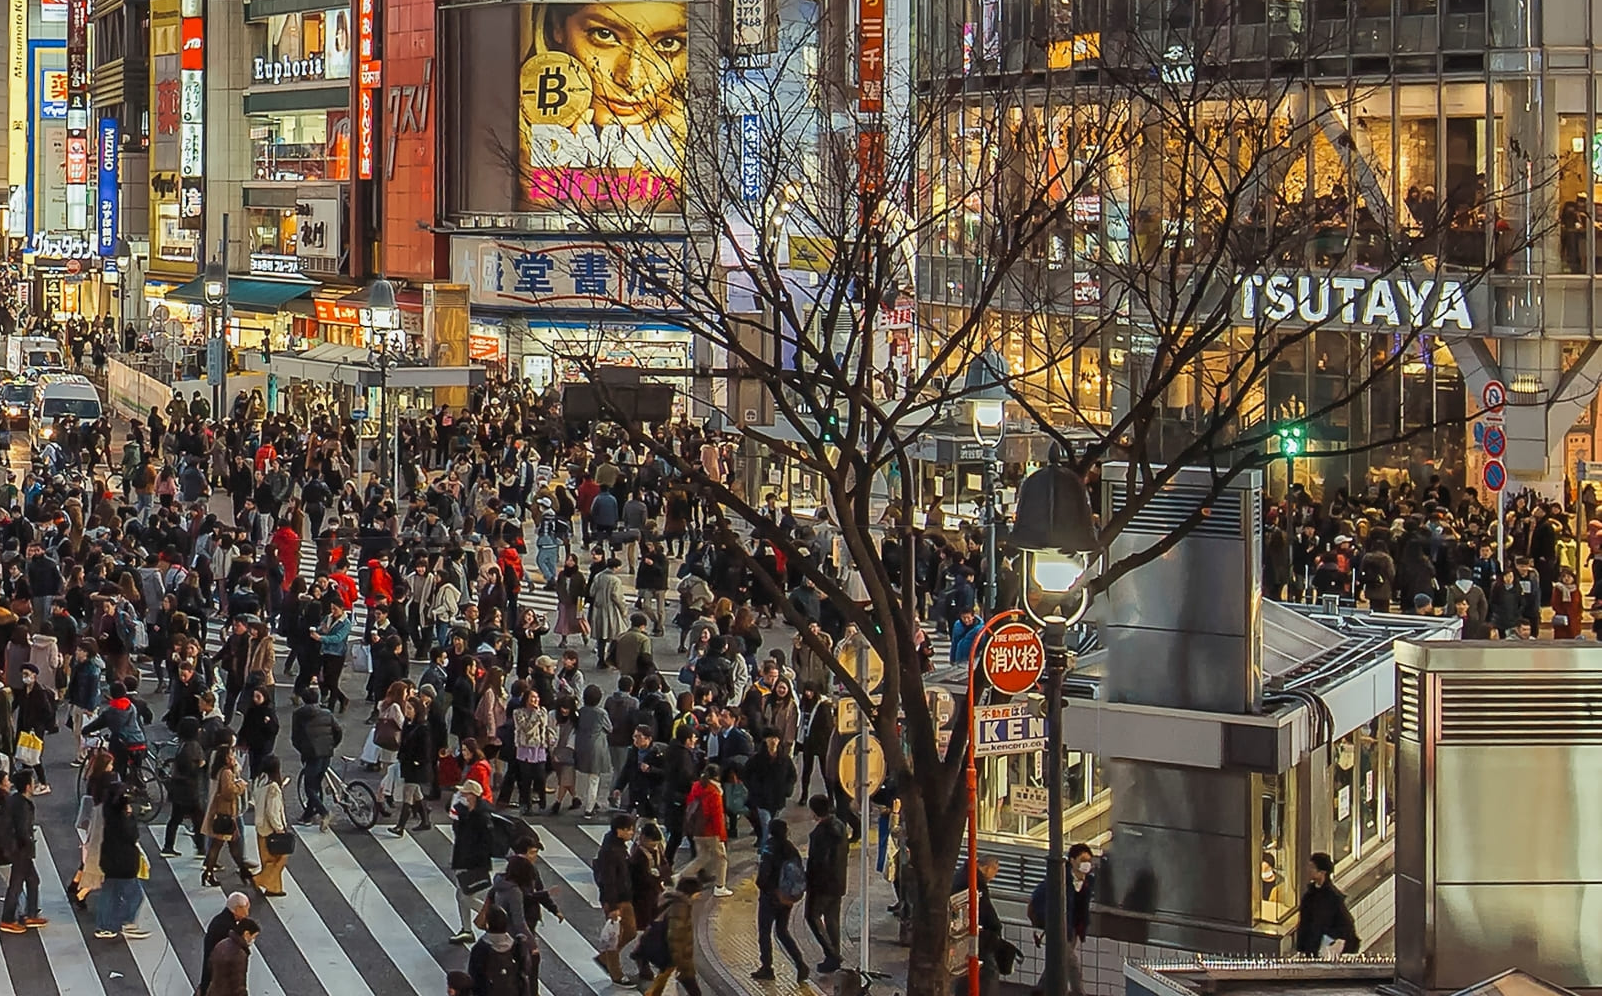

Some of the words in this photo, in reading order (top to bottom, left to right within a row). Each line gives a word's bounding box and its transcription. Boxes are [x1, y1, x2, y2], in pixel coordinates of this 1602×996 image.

[253, 55, 323, 85] Euphoria
[386, 58, 432, 181] クスリ
[104, 128, 115, 172] MIZUHO
[529, 169, 676, 200] Bitcoin
[32, 231, 100, 260] グルメタウン
[459, 251, 672, 296] 大盛堂書店
[1234, 274, 1472, 330] TSUTAYA
[994, 634, 1007, 643] FIRE
[1007, 632, 1034, 643] HYDRANT
[990, 644, 1039, 674] 消火栓
[985, 717, 1044, 743] KEN
